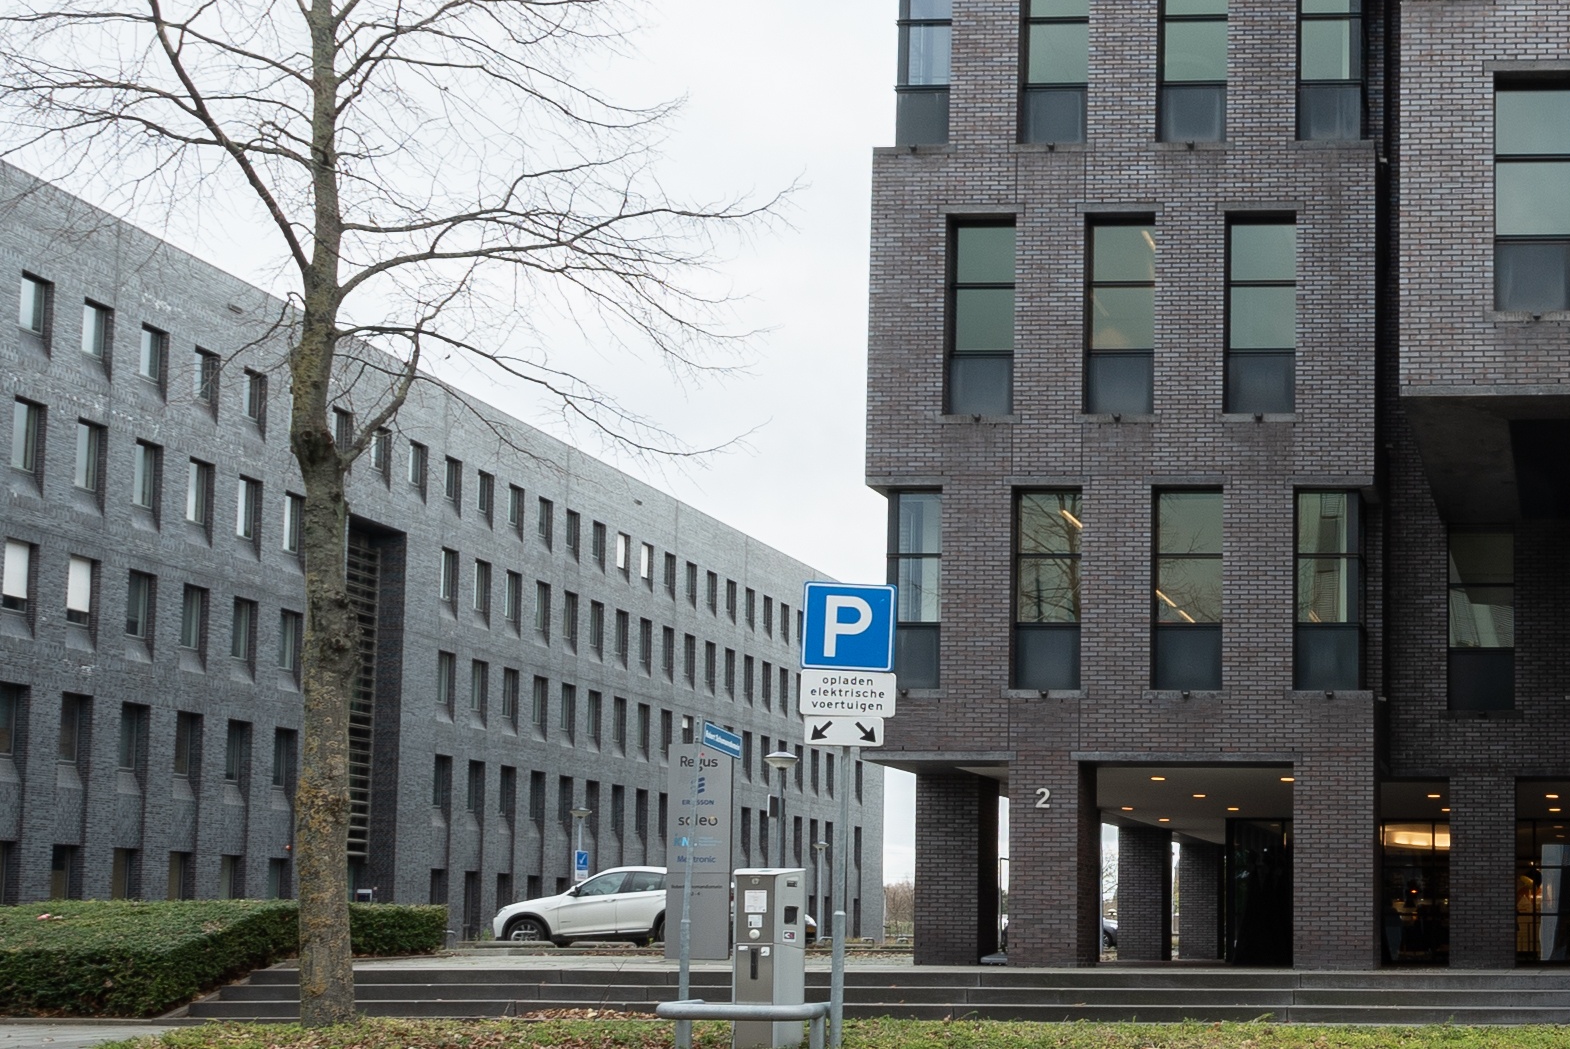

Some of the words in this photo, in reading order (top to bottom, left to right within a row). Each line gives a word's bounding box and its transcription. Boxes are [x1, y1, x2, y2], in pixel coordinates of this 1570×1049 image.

[823, 594, 873, 658] P
[822, 675, 874, 687] opladen
[810, 687, 885, 699] elektrische
[811, 699, 883, 713] voertuigen
[1035, 787, 1050, 809] 2
[677, 855, 716, 863] Metronic
